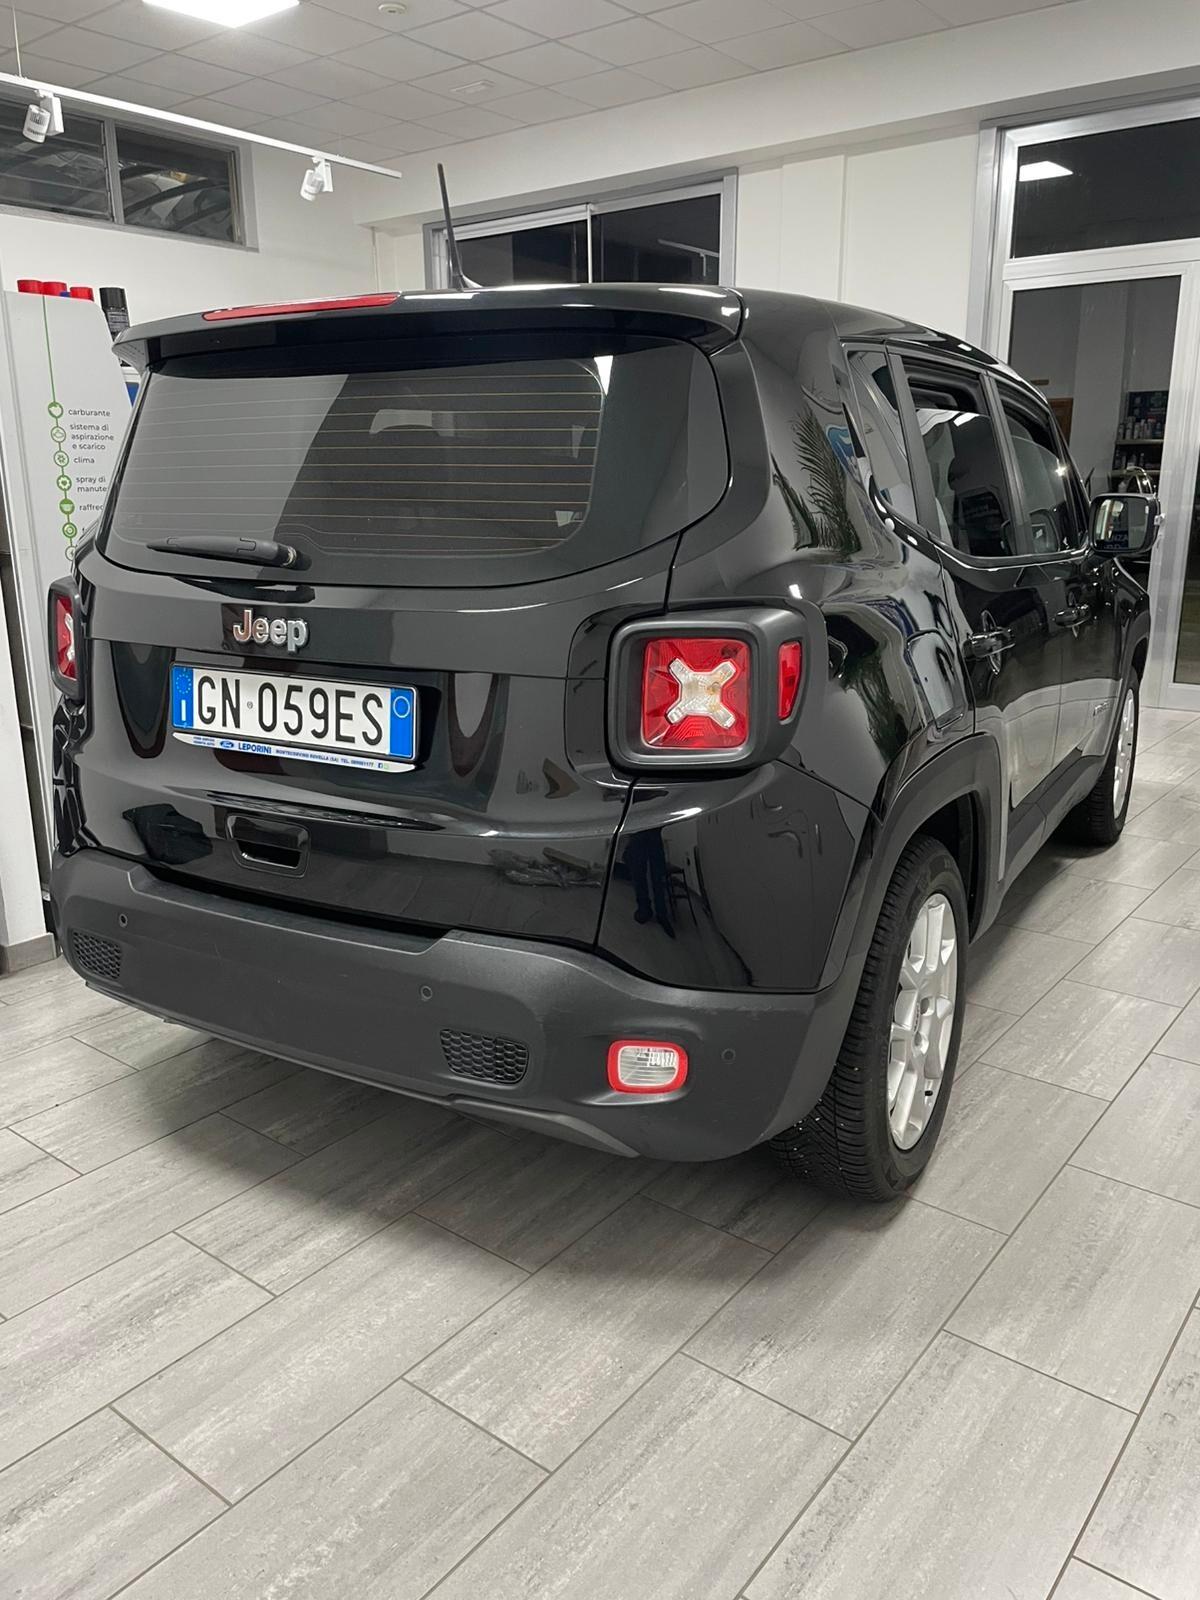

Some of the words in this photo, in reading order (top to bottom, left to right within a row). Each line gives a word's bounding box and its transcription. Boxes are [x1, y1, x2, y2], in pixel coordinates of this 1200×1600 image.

[68, 409, 111, 417] carburante
[70, 423, 100, 431] sistema
[101, 423, 110, 431] di
[71, 432, 114, 441] aspirazione
[79, 442, 106, 450] scarico
[73, 456, 95, 464] clima
[76, 476, 97, 485] spray
[97, 475, 106, 483] di
[233, 609, 308, 652] Jeep
[198, 675, 240, 729] GN
[258, 681, 383, 746] 059ES
[238, 742, 272, 754] LEPORINI
